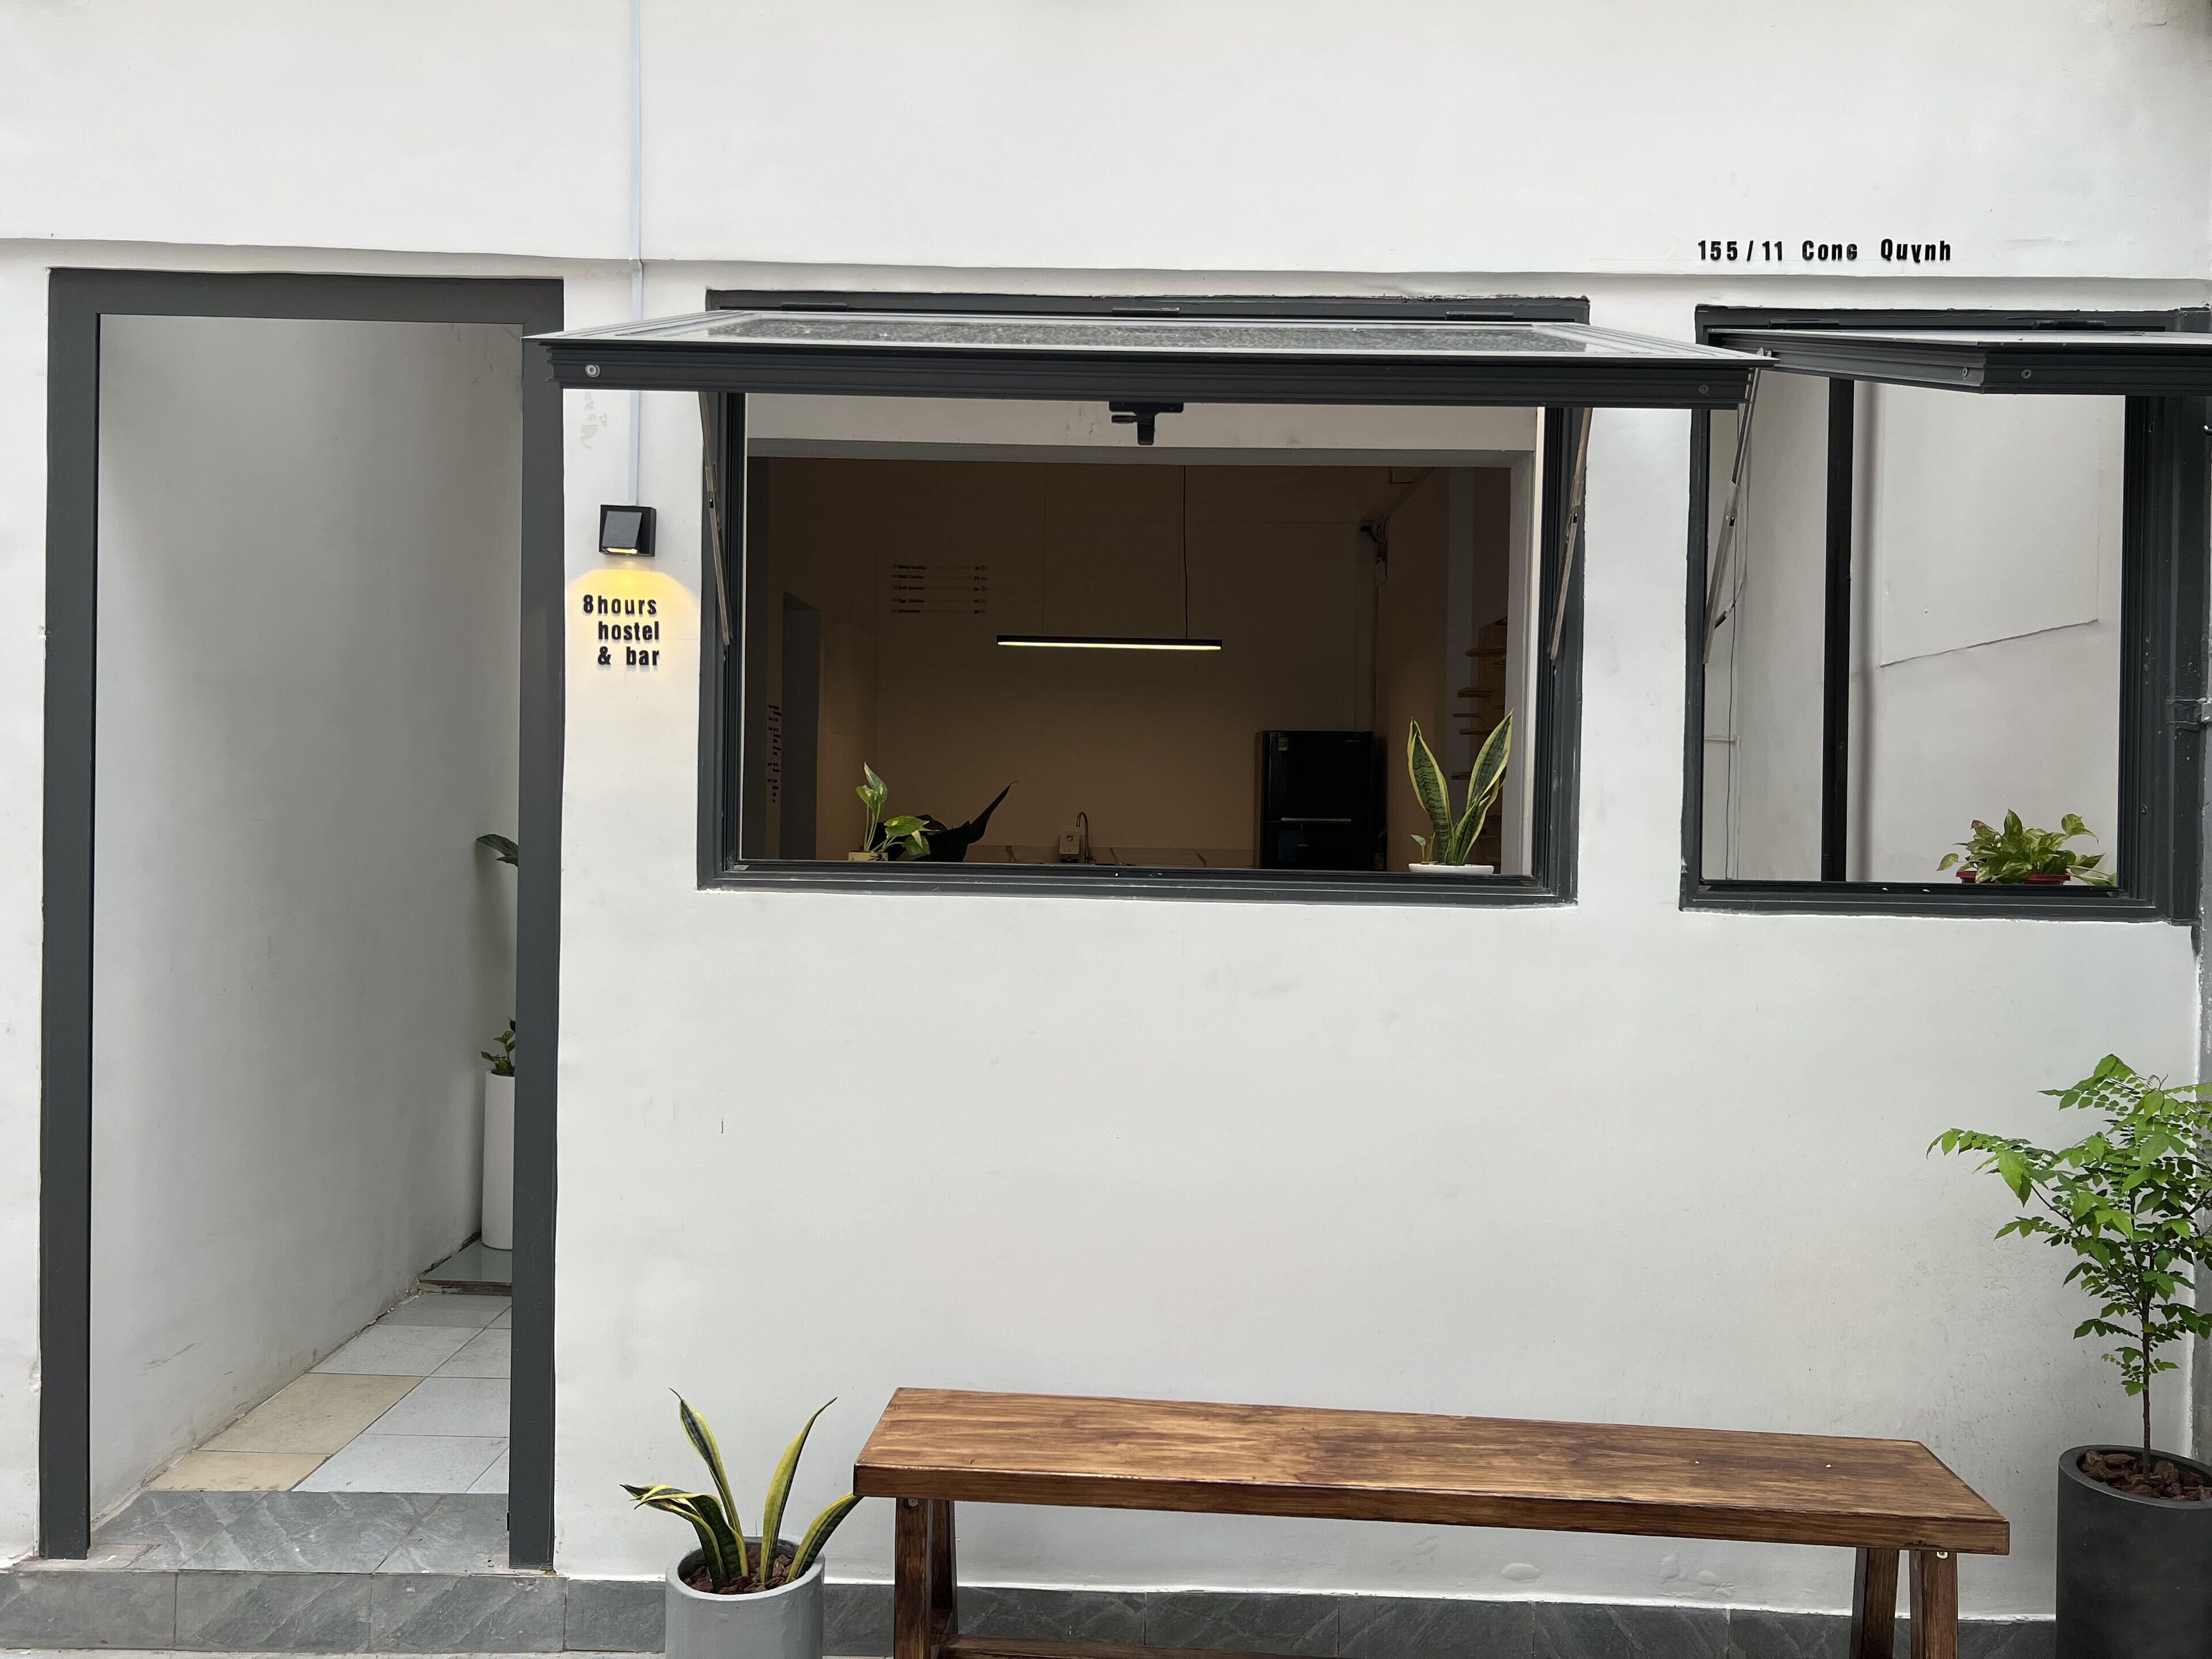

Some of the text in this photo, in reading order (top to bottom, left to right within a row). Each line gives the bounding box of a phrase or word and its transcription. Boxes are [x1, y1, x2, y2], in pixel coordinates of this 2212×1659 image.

[1697, 240, 1782, 262] 155/11
[1880, 238, 1951, 264] Quynh
[583, 594, 657, 615] 8hours
[598, 620, 660, 641] hostel
[597, 646, 660, 666] & bar
